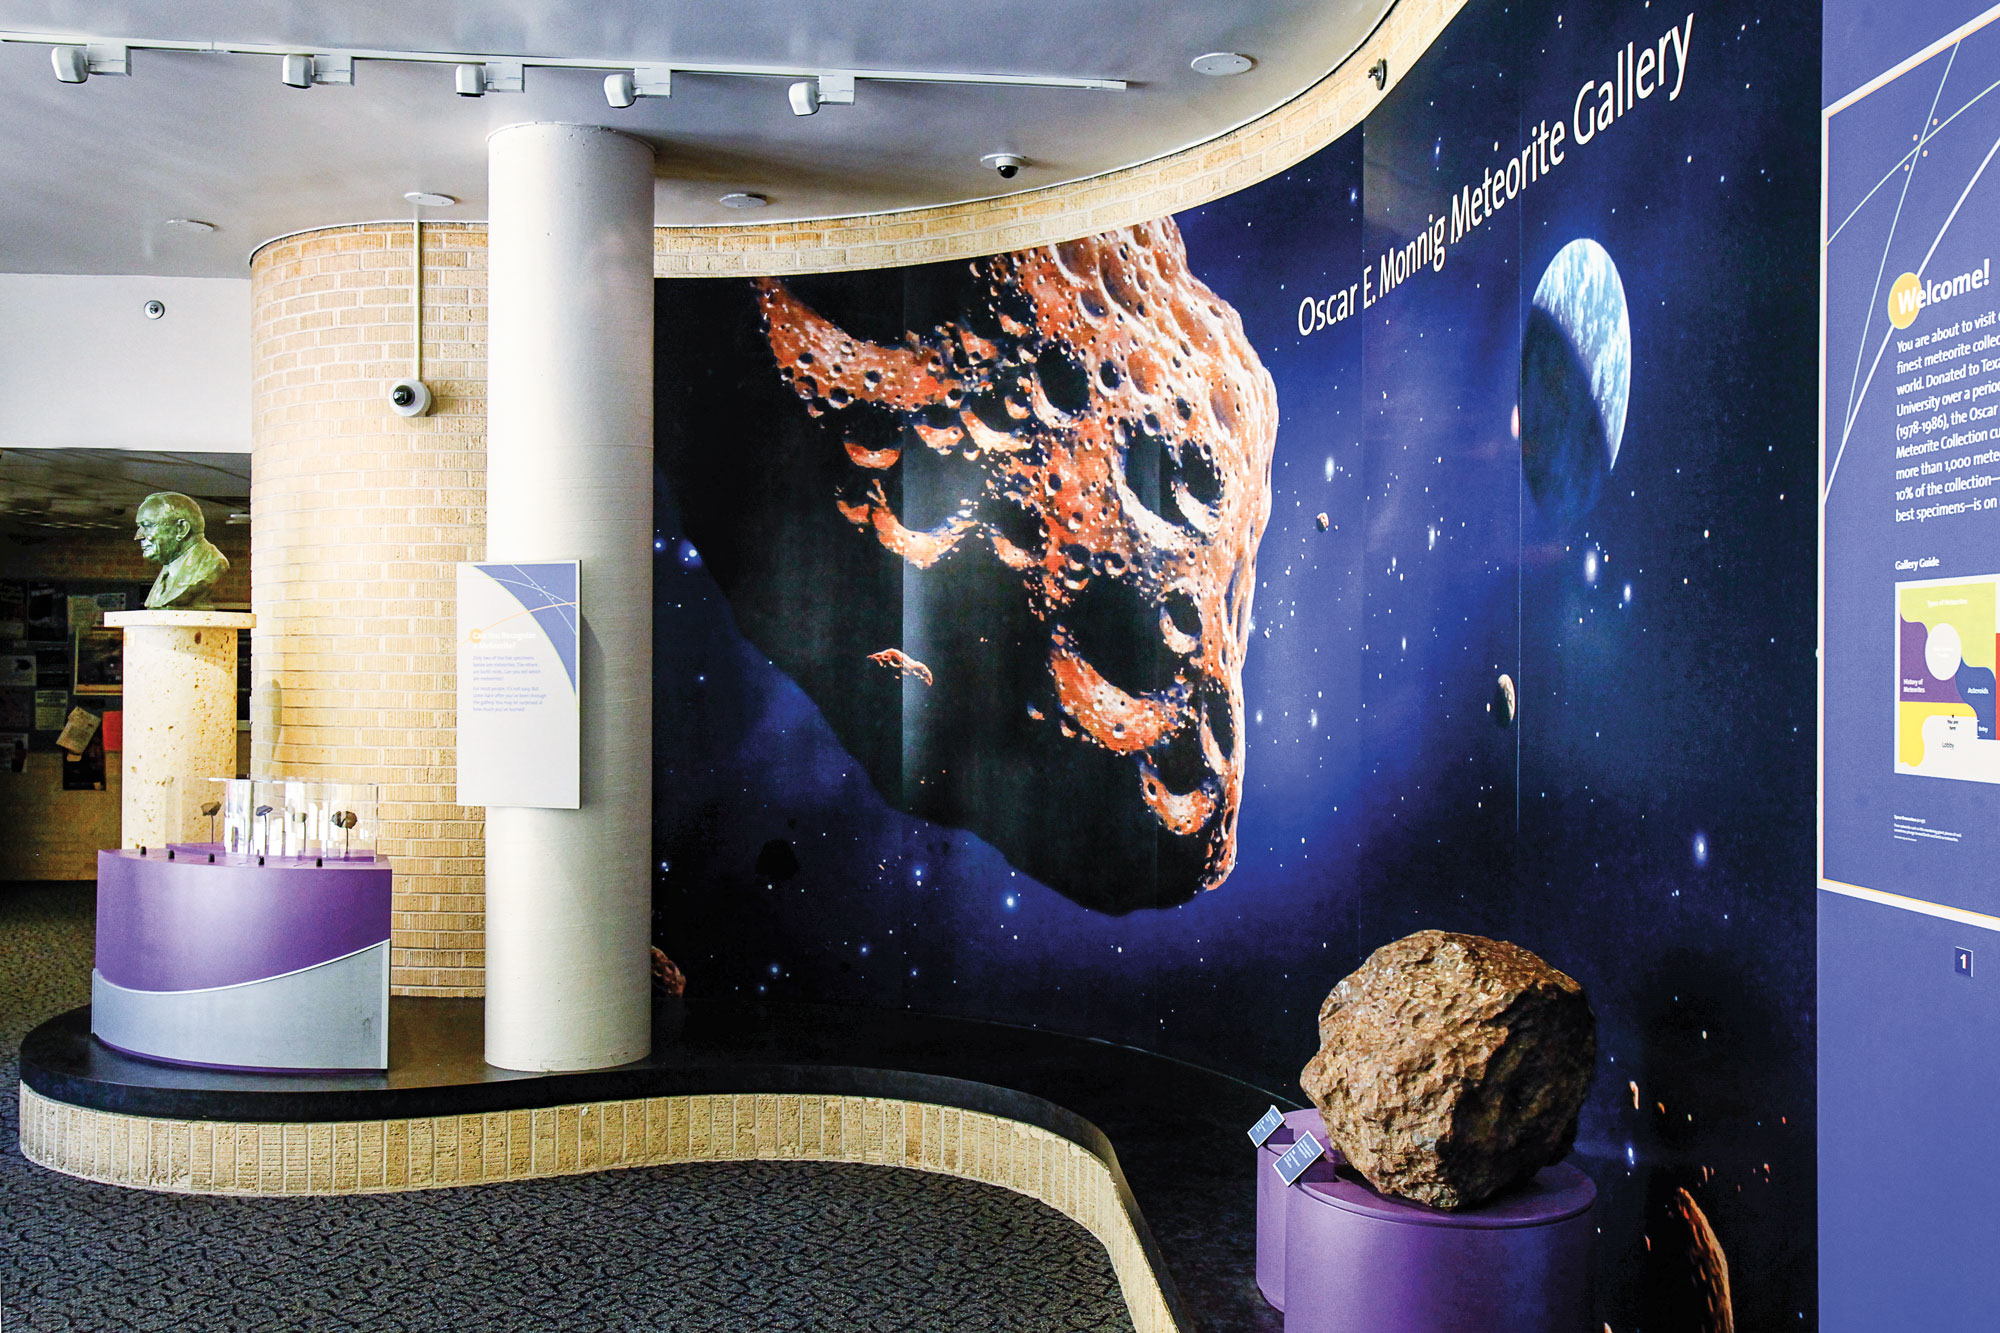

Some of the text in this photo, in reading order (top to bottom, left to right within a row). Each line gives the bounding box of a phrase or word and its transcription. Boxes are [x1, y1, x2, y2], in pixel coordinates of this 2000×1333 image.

[1297, 13, 1694, 336] Oscar E. Monnig Meteorite Gallery
[1897, 258, 1990, 315] Welcome!
[1896, 340, 1914, 354] You
[1914, 334, 1930, 348] are
[1931, 322, 1960, 343] about
[1961, 320, 1973, 333] to
[1974, 310, 1996, 329] visit
[1896, 356, 1923, 375] finest
[1924, 343, 1971, 367] meteorite
[1896, 376, 1925, 396] world.
[1926, 363, 1967, 388] Donated
[1968, 363, 1980, 376] to
[1896, 395, 1941, 417] University
[1941, 391, 1963, 405] over
[1963, 389, 1971, 400] a
[1950, 410, 1968, 425] the
[1969, 404, 1998, 421] Oscar
[1895, 439, 1940, 459] Meteorite
[1940, 429, 1988, 449] Collection
[1895, 466, 1920, 480] more
[1921, 461, 1943, 475] than
[1944, 456, 1972, 473] 1,000
[1895, 486, 1914, 501] 10%
[1915, 483, 1926, 498] of
[1926, 482, 1943, 496] the
[1895, 507, 1915, 522] best
[1983, 497, 1998, 509] on
[1894, 556, 1940, 572] Gallery Guide
[1960, 953, 1967, 969] 1
